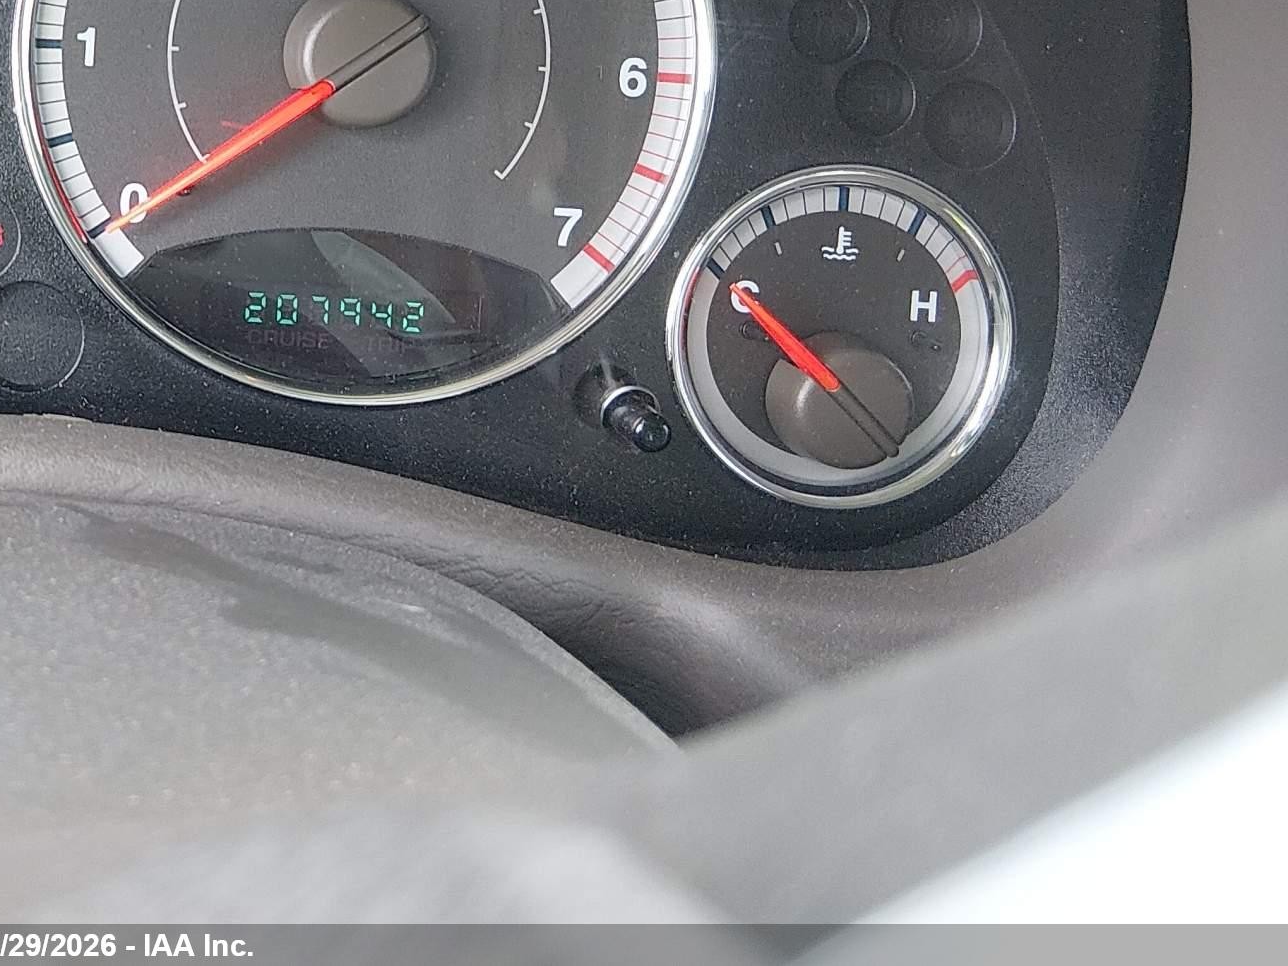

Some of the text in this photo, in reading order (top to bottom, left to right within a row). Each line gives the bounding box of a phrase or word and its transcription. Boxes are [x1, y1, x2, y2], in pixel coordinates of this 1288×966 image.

[77, 27, 95, 66] 1
[620, 58, 647, 97] 6
[120, 183, 148, 224] 0
[554, 208, 582, 246] 7
[244, 291, 424, 333] 207942
[730, 280, 760, 314] C
[910, 291, 937, 322] H
